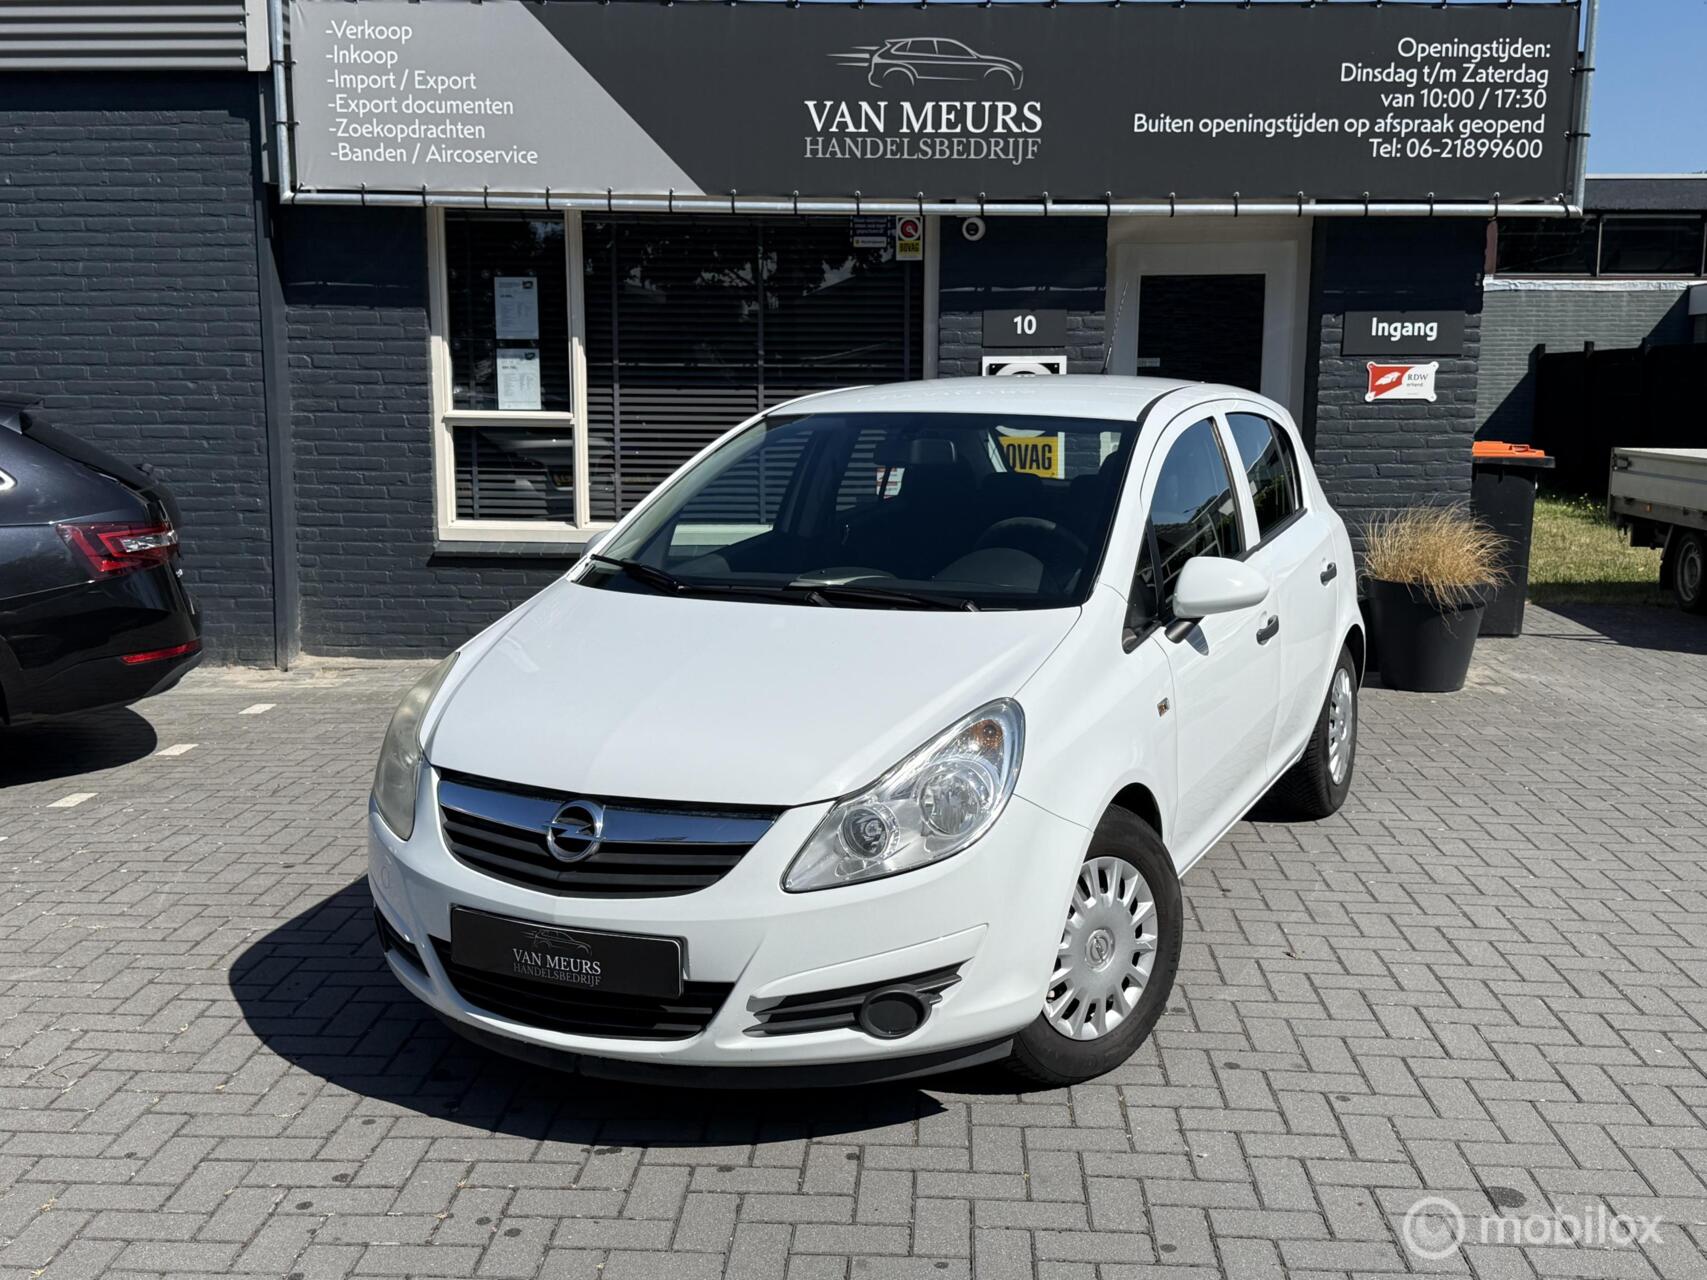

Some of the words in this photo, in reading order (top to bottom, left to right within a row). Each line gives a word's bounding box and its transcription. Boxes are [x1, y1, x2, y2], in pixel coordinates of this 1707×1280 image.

[325, 20, 413, 45] -Verkoop
[325, 44, 399, 68] -Inkoop
[1397, 38, 1551, 62] Openingstijden:
[326, 69, 396, 93] -Import
[400, 69, 409, 91] /
[414, 70, 477, 94] Export
[1340, 62, 1418, 88] Dinsdag
[1422, 62, 1457, 86] t/m
[1461, 63, 1549, 88] Zaterdag
[327, 94, 398, 118] -Export
[401, 95, 514, 116] documenten
[1380, 92, 1415, 109] van
[1420, 88, 1475, 109] 10:00
[1479, 88, 1490, 110] /
[1494, 87, 1547, 109] 17:30
[804, 100, 888, 133] VAN
[900, 101, 1043, 134] MEURS
[1133, 113, 1194, 134] Buiten
[1198, 112, 1339, 138] openingstijden
[1343, 118, 1370, 138] op
[1374, 113, 1455, 138] afspraak
[1458, 113, 1545, 139] geopend
[328, 118, 486, 143] -Zoekopdrachten
[330, 143, 407, 163] -Banden
[411, 143, 421, 165] /
[425, 145, 538, 165] Aircoservice
[804, 137, 1042, 166] HANDELSBEDRIJF
[1369, 138, 1402, 158] Tel:
[1406, 138, 1543, 159] 06-21899600
[1013, 314, 1037, 335] 10
[1371, 316, 1438, 342] Ingang
[1407, 373, 1428, 381] RDW
[1005, 443, 1052, 470] OVAG
[513, 948, 542, 966] VAN
[546, 955, 601, 975] MEURS
[513, 962, 601, 987] HANDELSBEDRIJF
